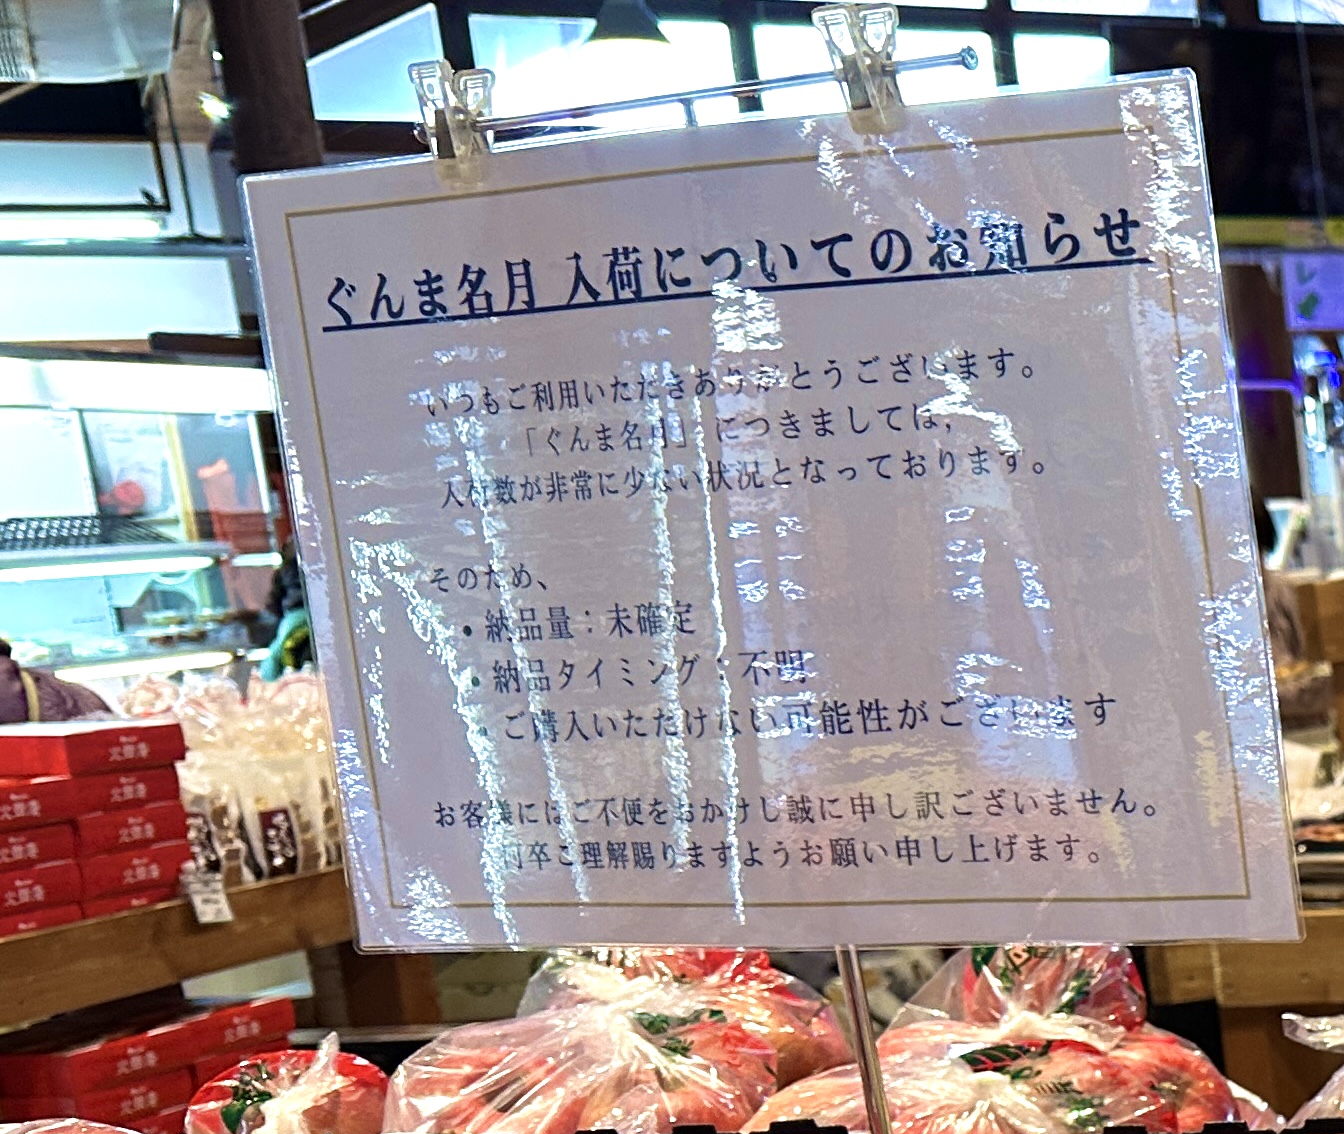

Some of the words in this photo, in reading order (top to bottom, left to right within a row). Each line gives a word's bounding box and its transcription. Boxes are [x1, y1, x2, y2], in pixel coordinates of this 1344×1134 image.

[326, 258, 536, 325] ぐんま名月
[566, 208, 1141, 304] 入荷についてのお知らせ
[429, 563, 548, 592] そのため、
